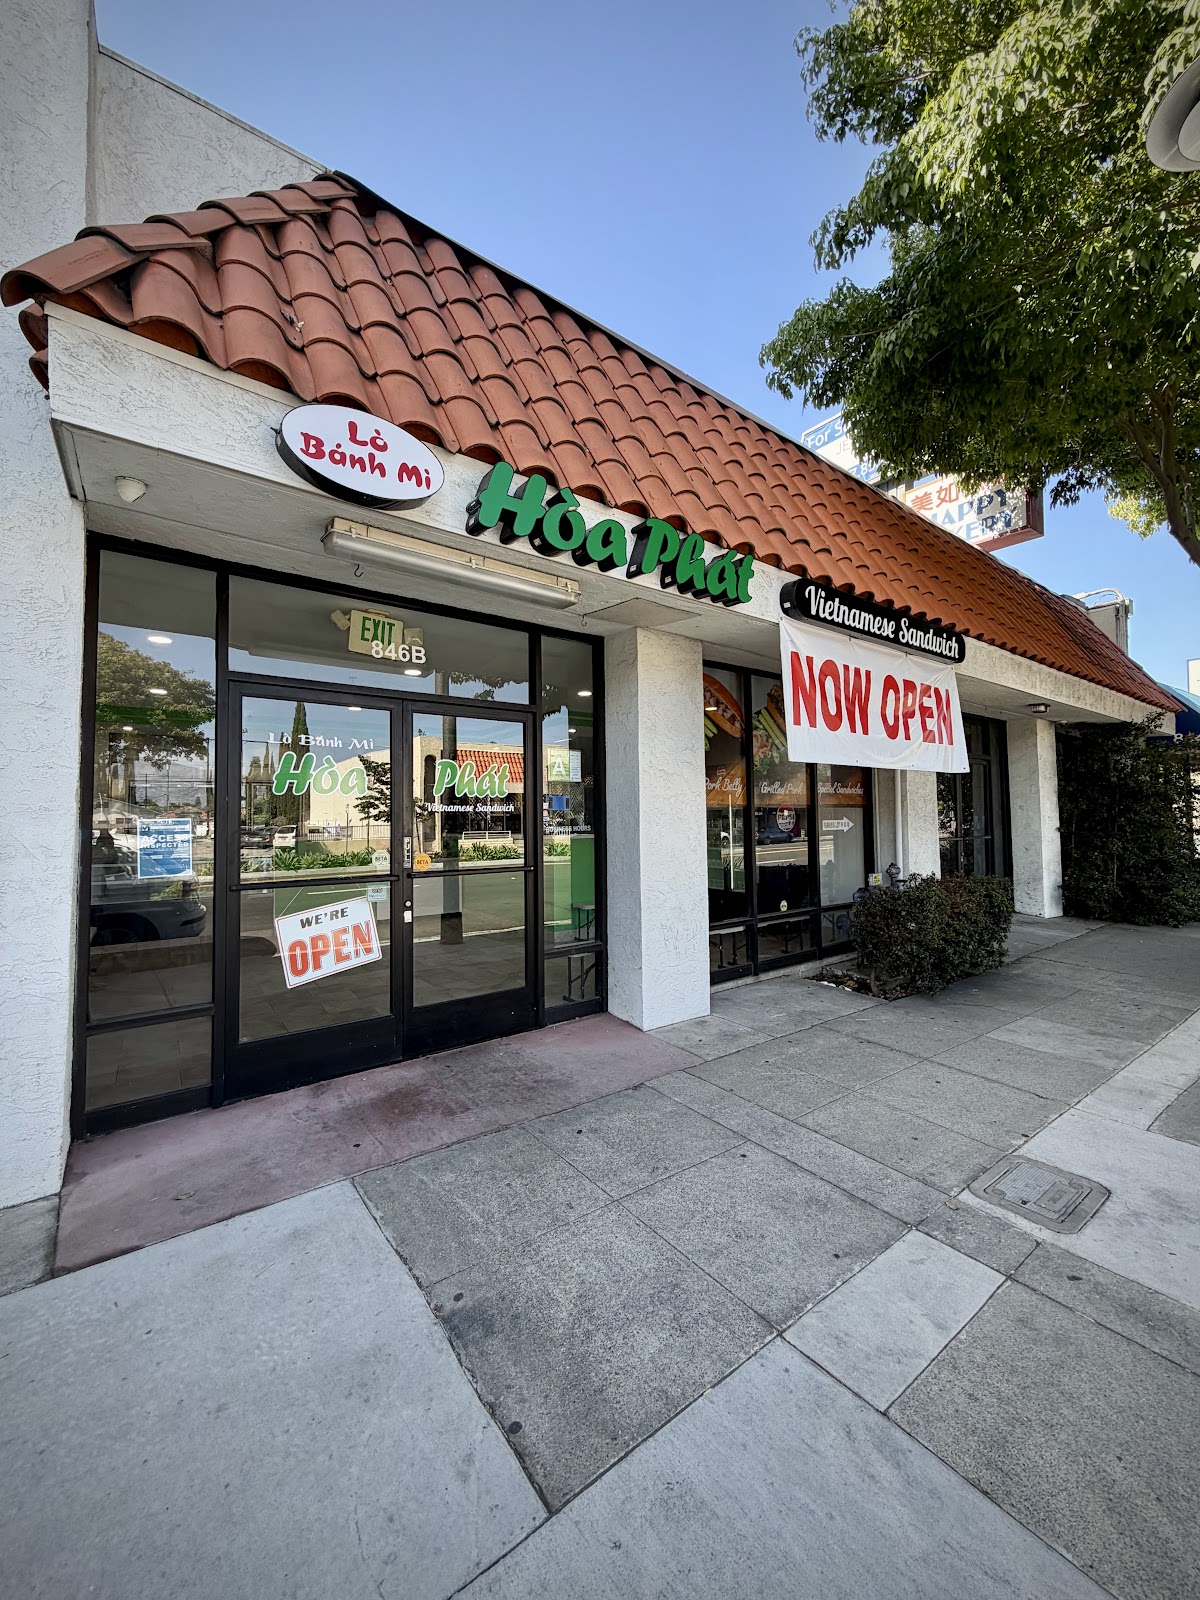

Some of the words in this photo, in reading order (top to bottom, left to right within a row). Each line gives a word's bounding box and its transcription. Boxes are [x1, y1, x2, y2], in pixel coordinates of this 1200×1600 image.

[348, 421, 388, 452] Lò
[806, 429, 831, 449] For
[300, 432, 386, 478] Bánh
[476, 461, 628, 568] Hòa
[640, 517, 754, 603] Phát
[360, 616, 395, 646] EXIT
[805, 585, 895, 638] Vietnamese
[899, 618, 959, 659] Sandwich
[371, 640, 426, 664] 846B
[790, 651, 871, 735] NOW
[881, 674, 954, 746] OPEN
[272, 751, 368, 796] Hòa
[433, 759, 510, 798] Phát
[552, 757, 566, 774] A
[722, 778, 743, 797] Belly
[761, 781, 786, 794] Grilled
[786, 783, 803, 795] Pork
[425, 802, 474, 812] Vietnamese
[476, 803, 515, 812] Sandwich
[777, 812, 795, 821] PEPSI
[141, 834, 189, 843] ACCESS
[545, 825, 572, 833] BUSINESS
[300, 907, 349, 929] WE'RE
[288, 920, 374, 977] OPEN
